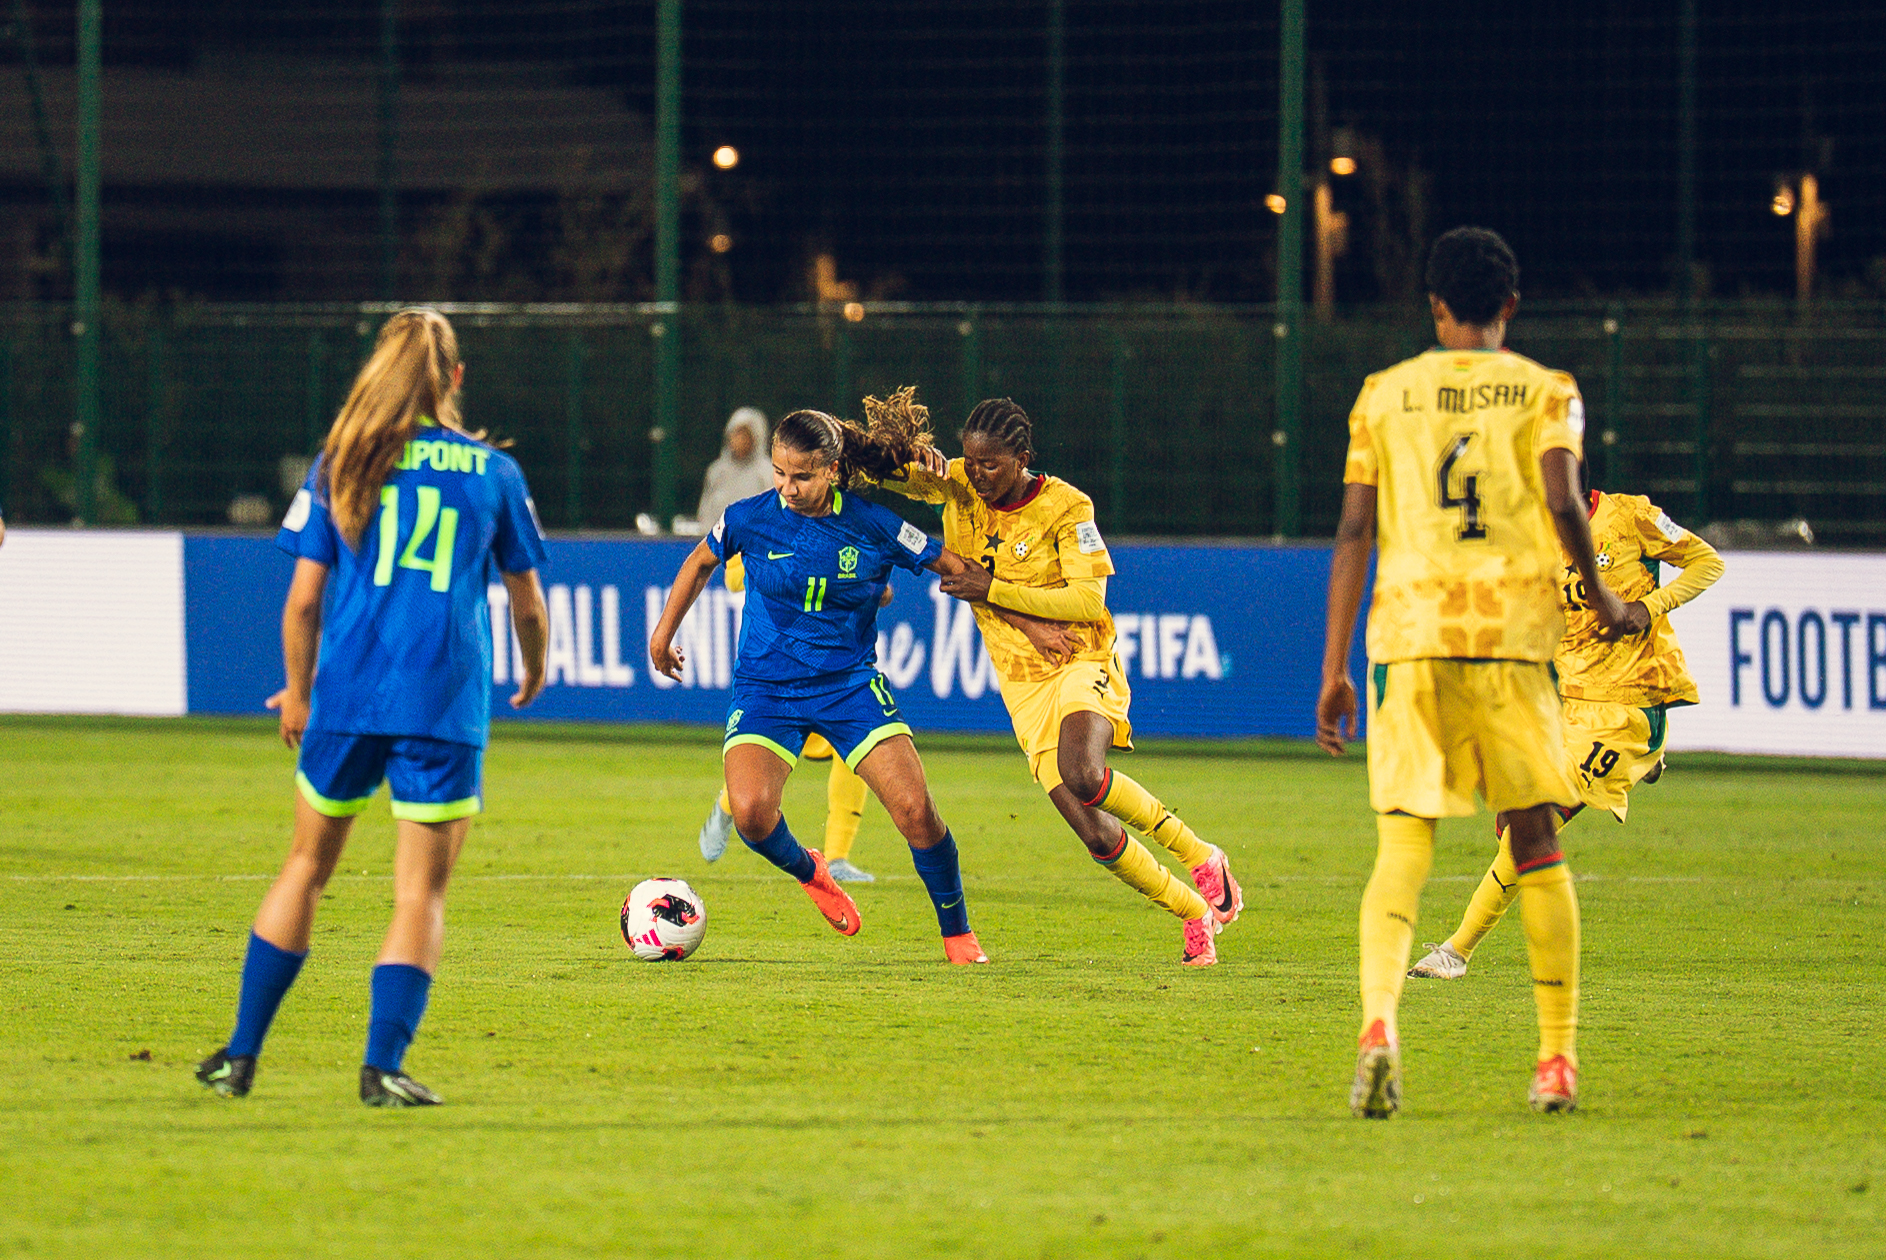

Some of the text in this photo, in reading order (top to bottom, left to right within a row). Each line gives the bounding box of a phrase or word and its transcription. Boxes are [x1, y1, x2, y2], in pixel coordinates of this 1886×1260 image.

[1402, 384, 1527, 414] L. MUSAH
[1434, 432, 1491, 544] 4
[374, 485, 460, 593] 14
[804, 576, 827, 612] 11
[1112, 612, 1222, 680] FIFA
[869, 673, 895, 706] 11
[1579, 741, 1621, 779] 19
